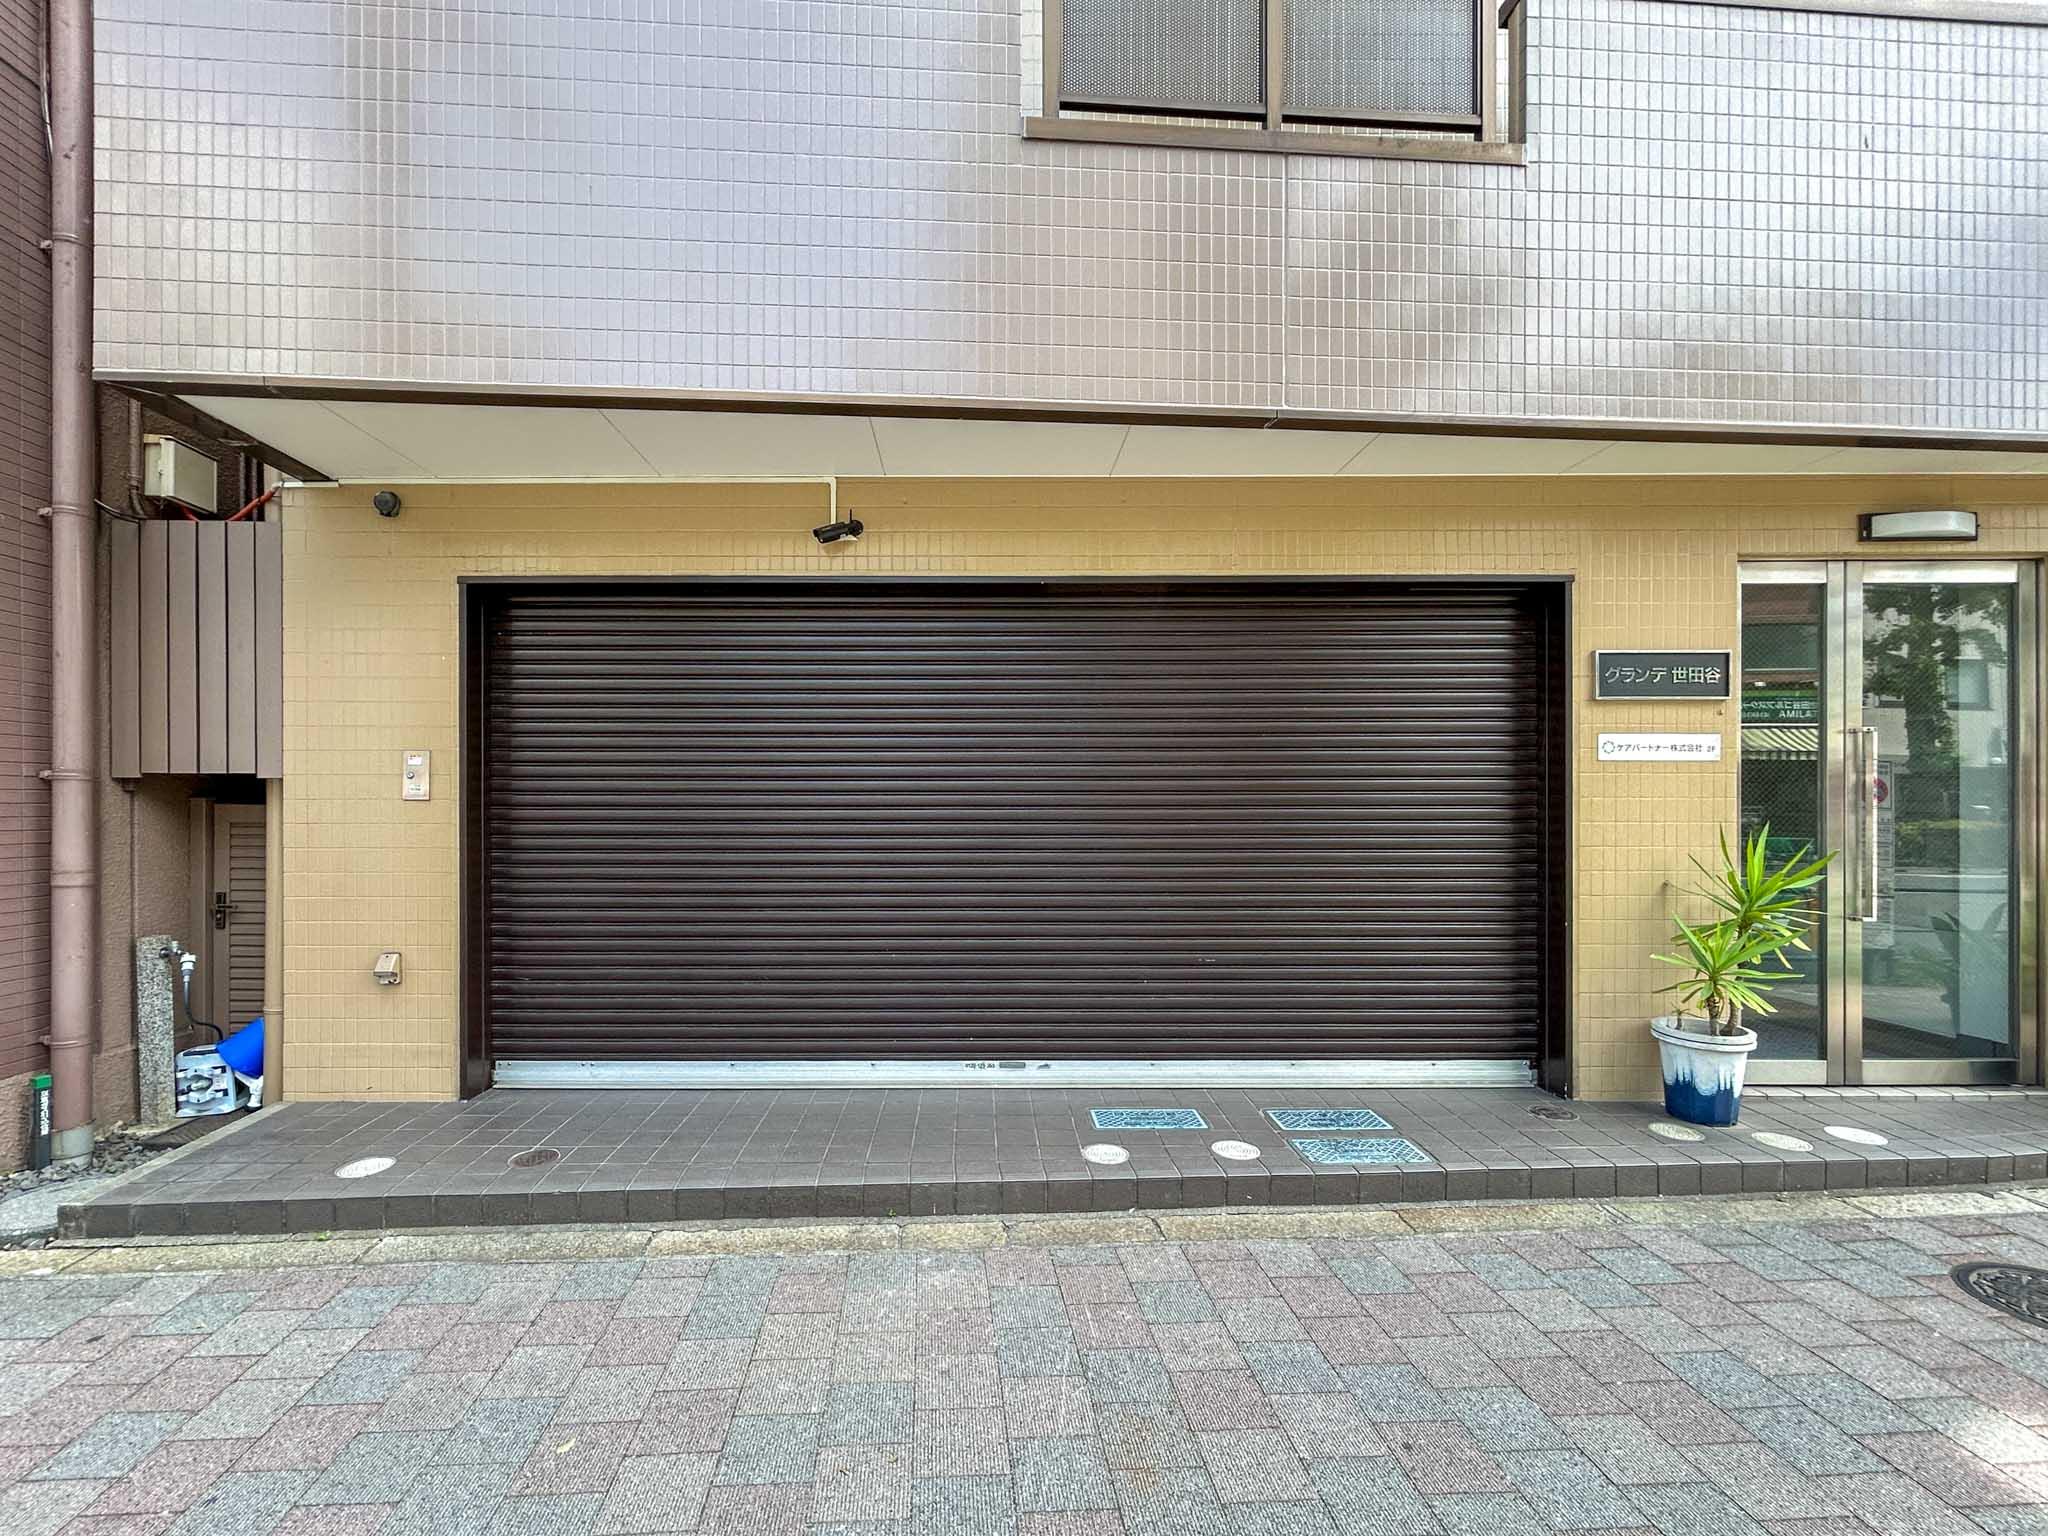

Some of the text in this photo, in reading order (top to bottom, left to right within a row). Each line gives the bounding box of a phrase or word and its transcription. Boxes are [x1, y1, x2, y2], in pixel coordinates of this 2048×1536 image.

[1604, 666, 1721, 684] グランデ 世田谷
